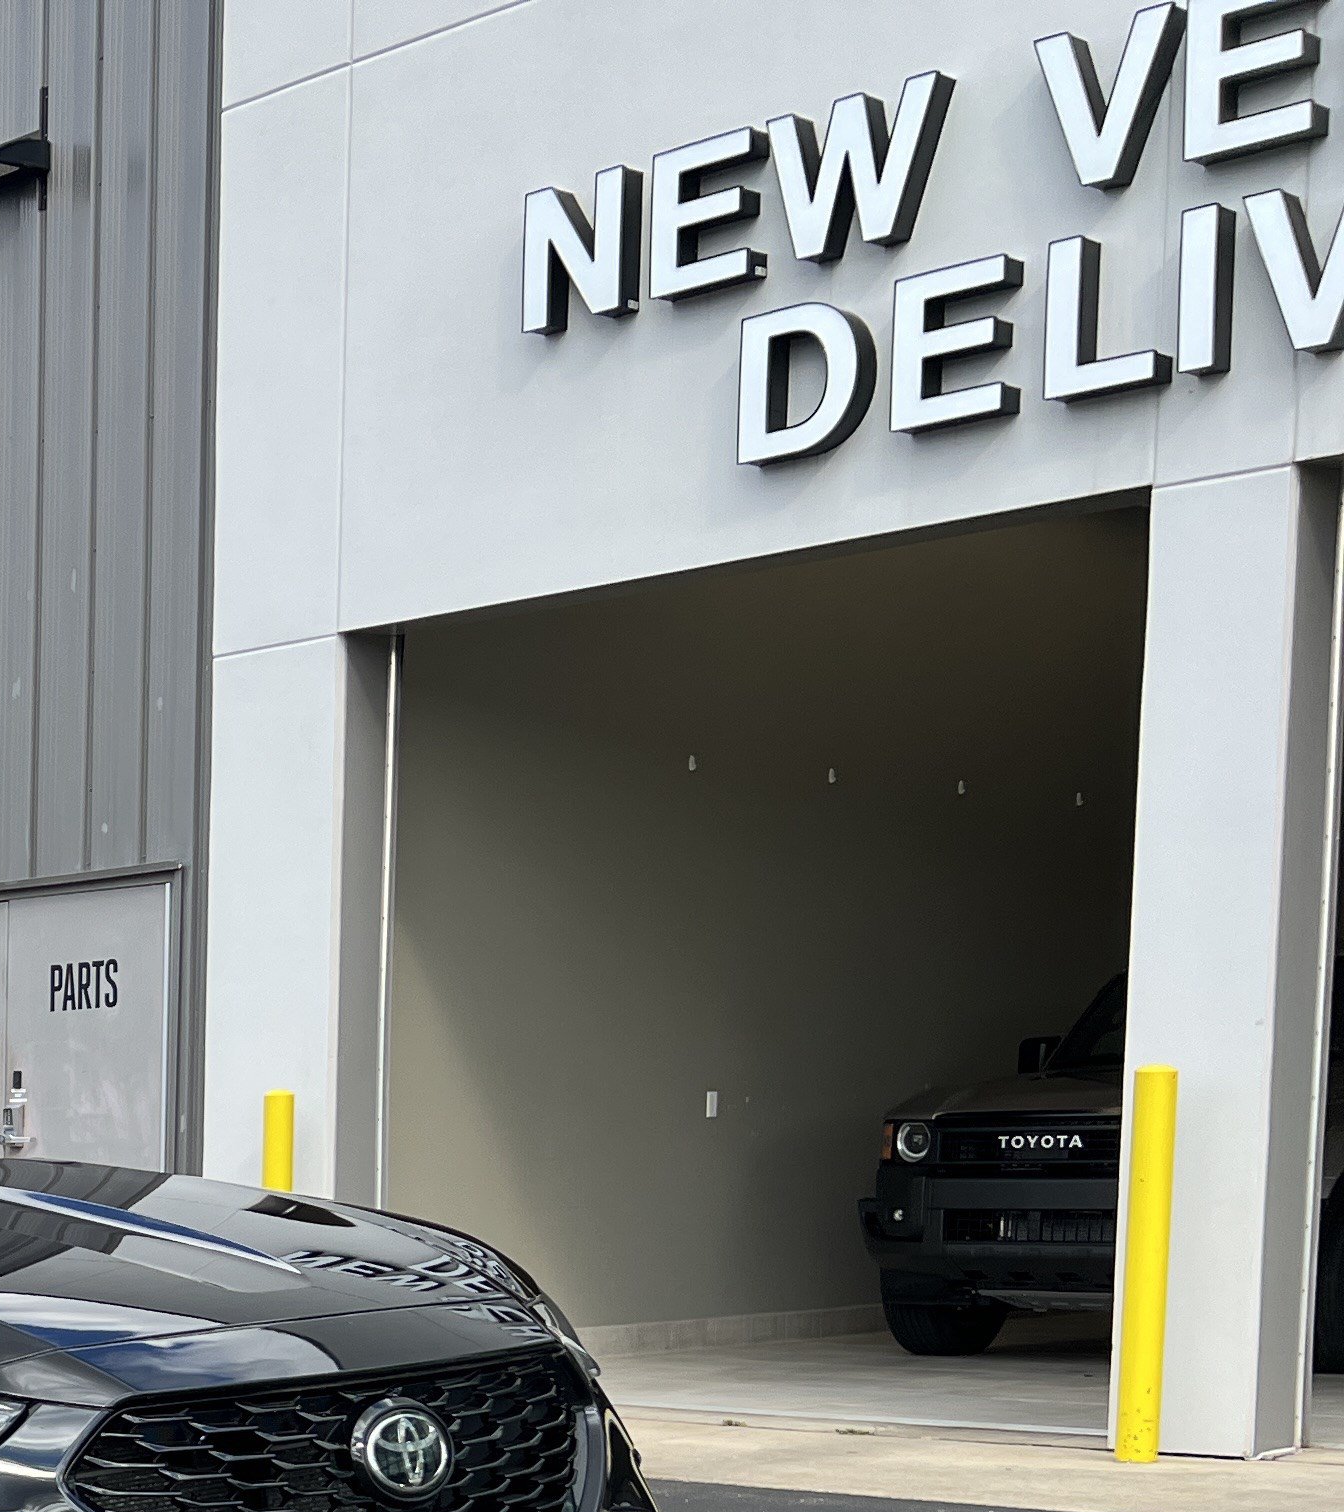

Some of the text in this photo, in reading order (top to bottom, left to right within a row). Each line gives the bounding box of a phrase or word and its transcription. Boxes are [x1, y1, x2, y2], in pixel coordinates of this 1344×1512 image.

[521, 0, 1330, 336] NEW VE
[736, 188, 1344, 467] DELIV
[50, 958, 118, 1013] PARTS
[997, 1134, 1083, 1149] TOYOTA
